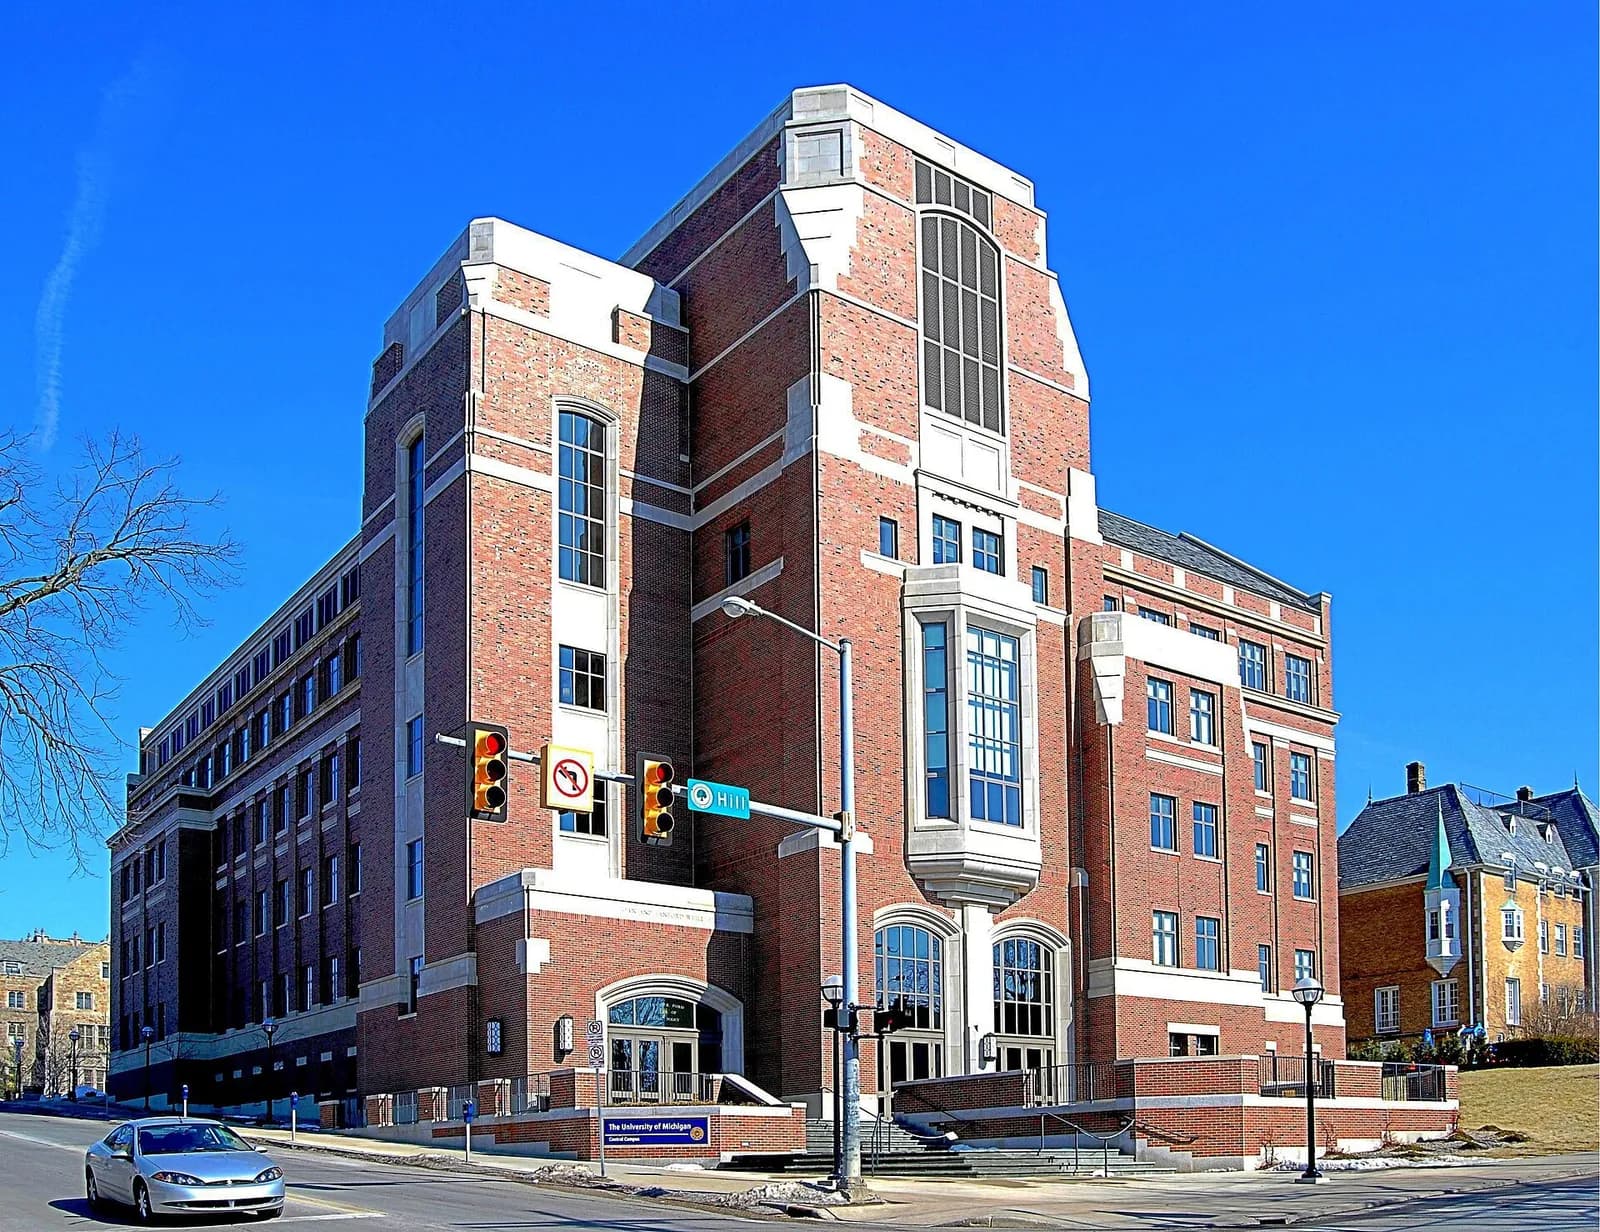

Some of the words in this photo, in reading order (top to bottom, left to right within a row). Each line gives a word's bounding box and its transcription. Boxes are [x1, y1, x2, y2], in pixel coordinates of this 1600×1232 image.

[717, 791, 745, 810] Hill
[621, 1122, 652, 1132] University
[654, 1122, 661, 1130] of
[662, 1122, 692, 1132] Michigan
